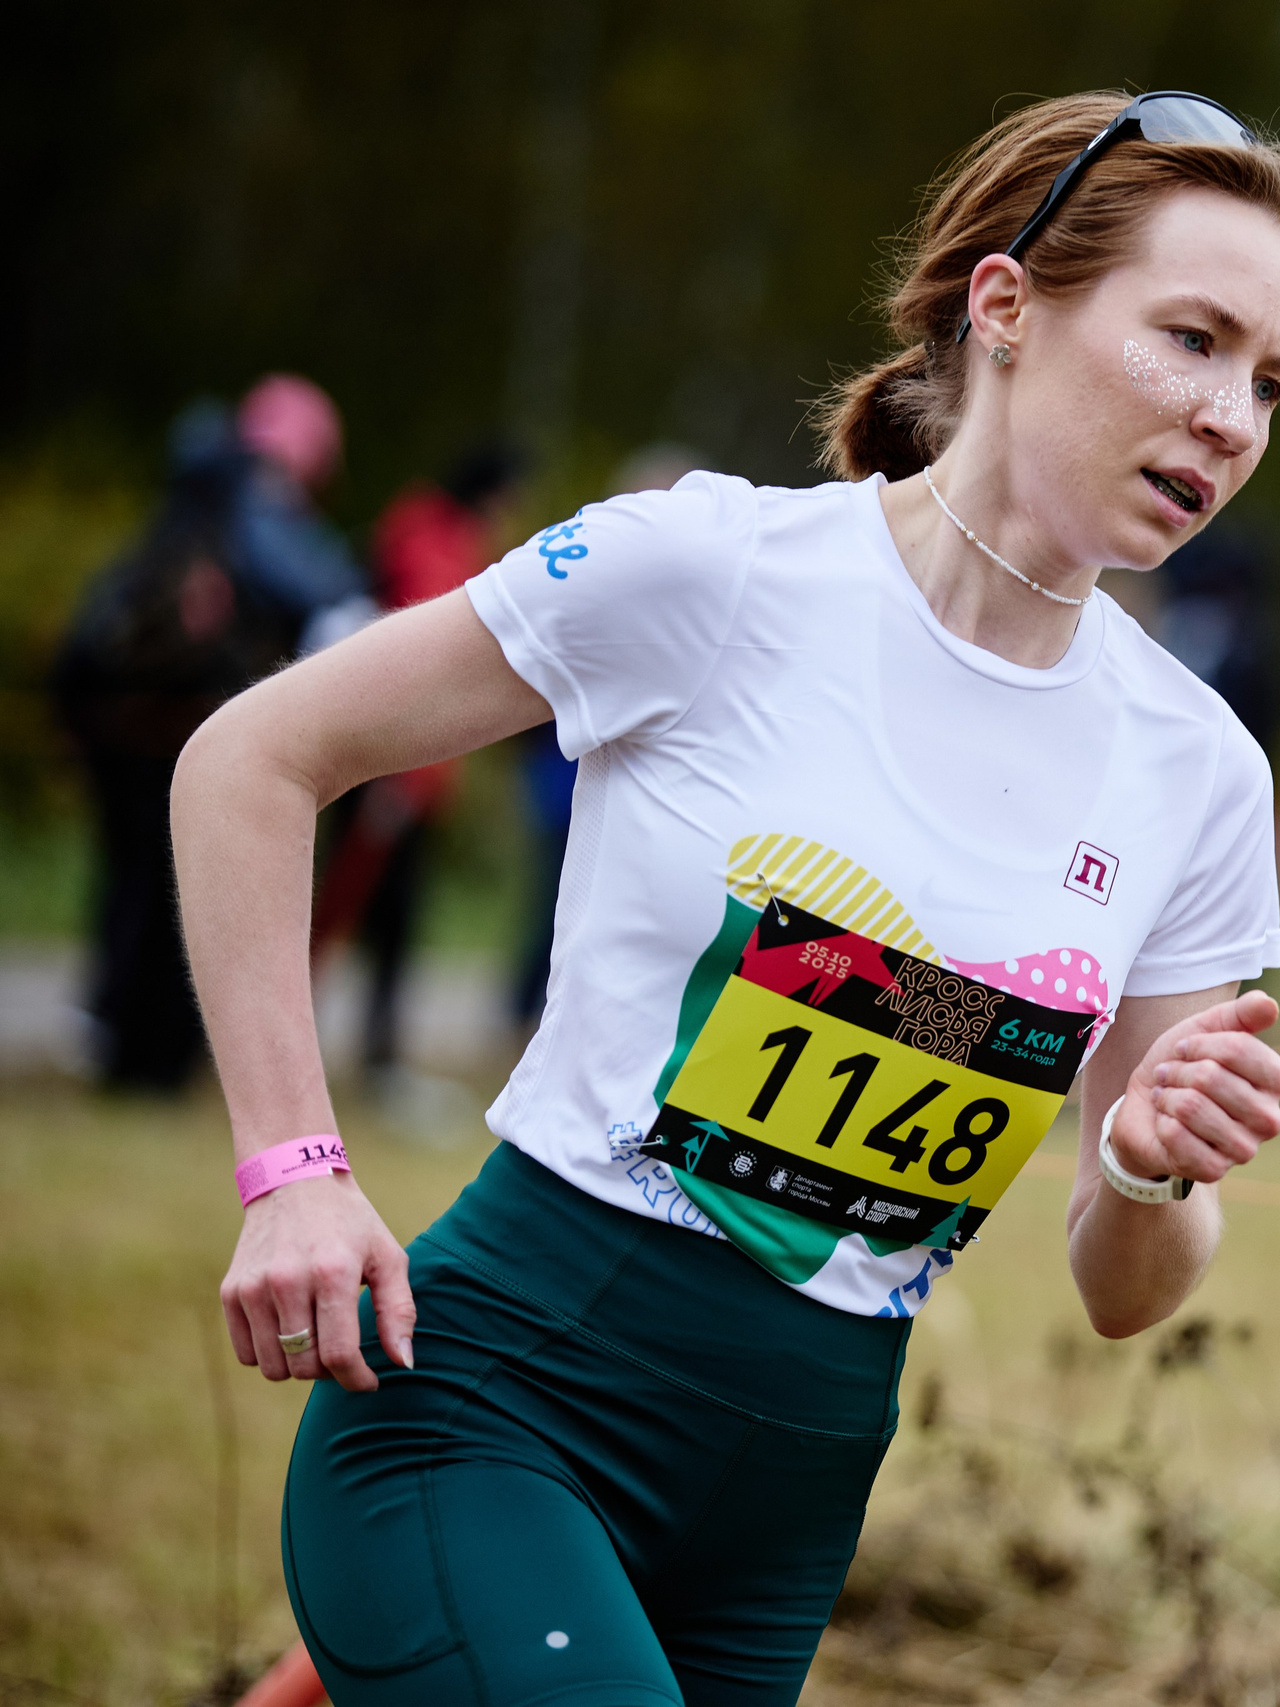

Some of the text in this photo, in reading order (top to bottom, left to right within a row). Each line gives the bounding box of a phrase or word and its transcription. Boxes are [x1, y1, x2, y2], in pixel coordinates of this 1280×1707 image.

[798, 951, 848, 979] 2025
[805, 941, 852, 967] 05.10
[894, 957, 1005, 1019] КРОСС
[874, 982, 991, 1044] ЛИСЬЯ
[892, 1017, 972, 1068] ГОРА
[998, 1018, 1066, 1053] 6 КМ
[1029, 1053, 1056, 1066] года
[746, 1024, 1010, 1186] 1148
[791, 1181, 812, 1193] спорта
[794, 1174, 834, 1192] Департамент
[787, 1188, 832, 1208] города Москвы
[871, 1199, 921, 1220] МОСКОВСКИЙ
[865, 1209, 891, 1225] СПОРТ
